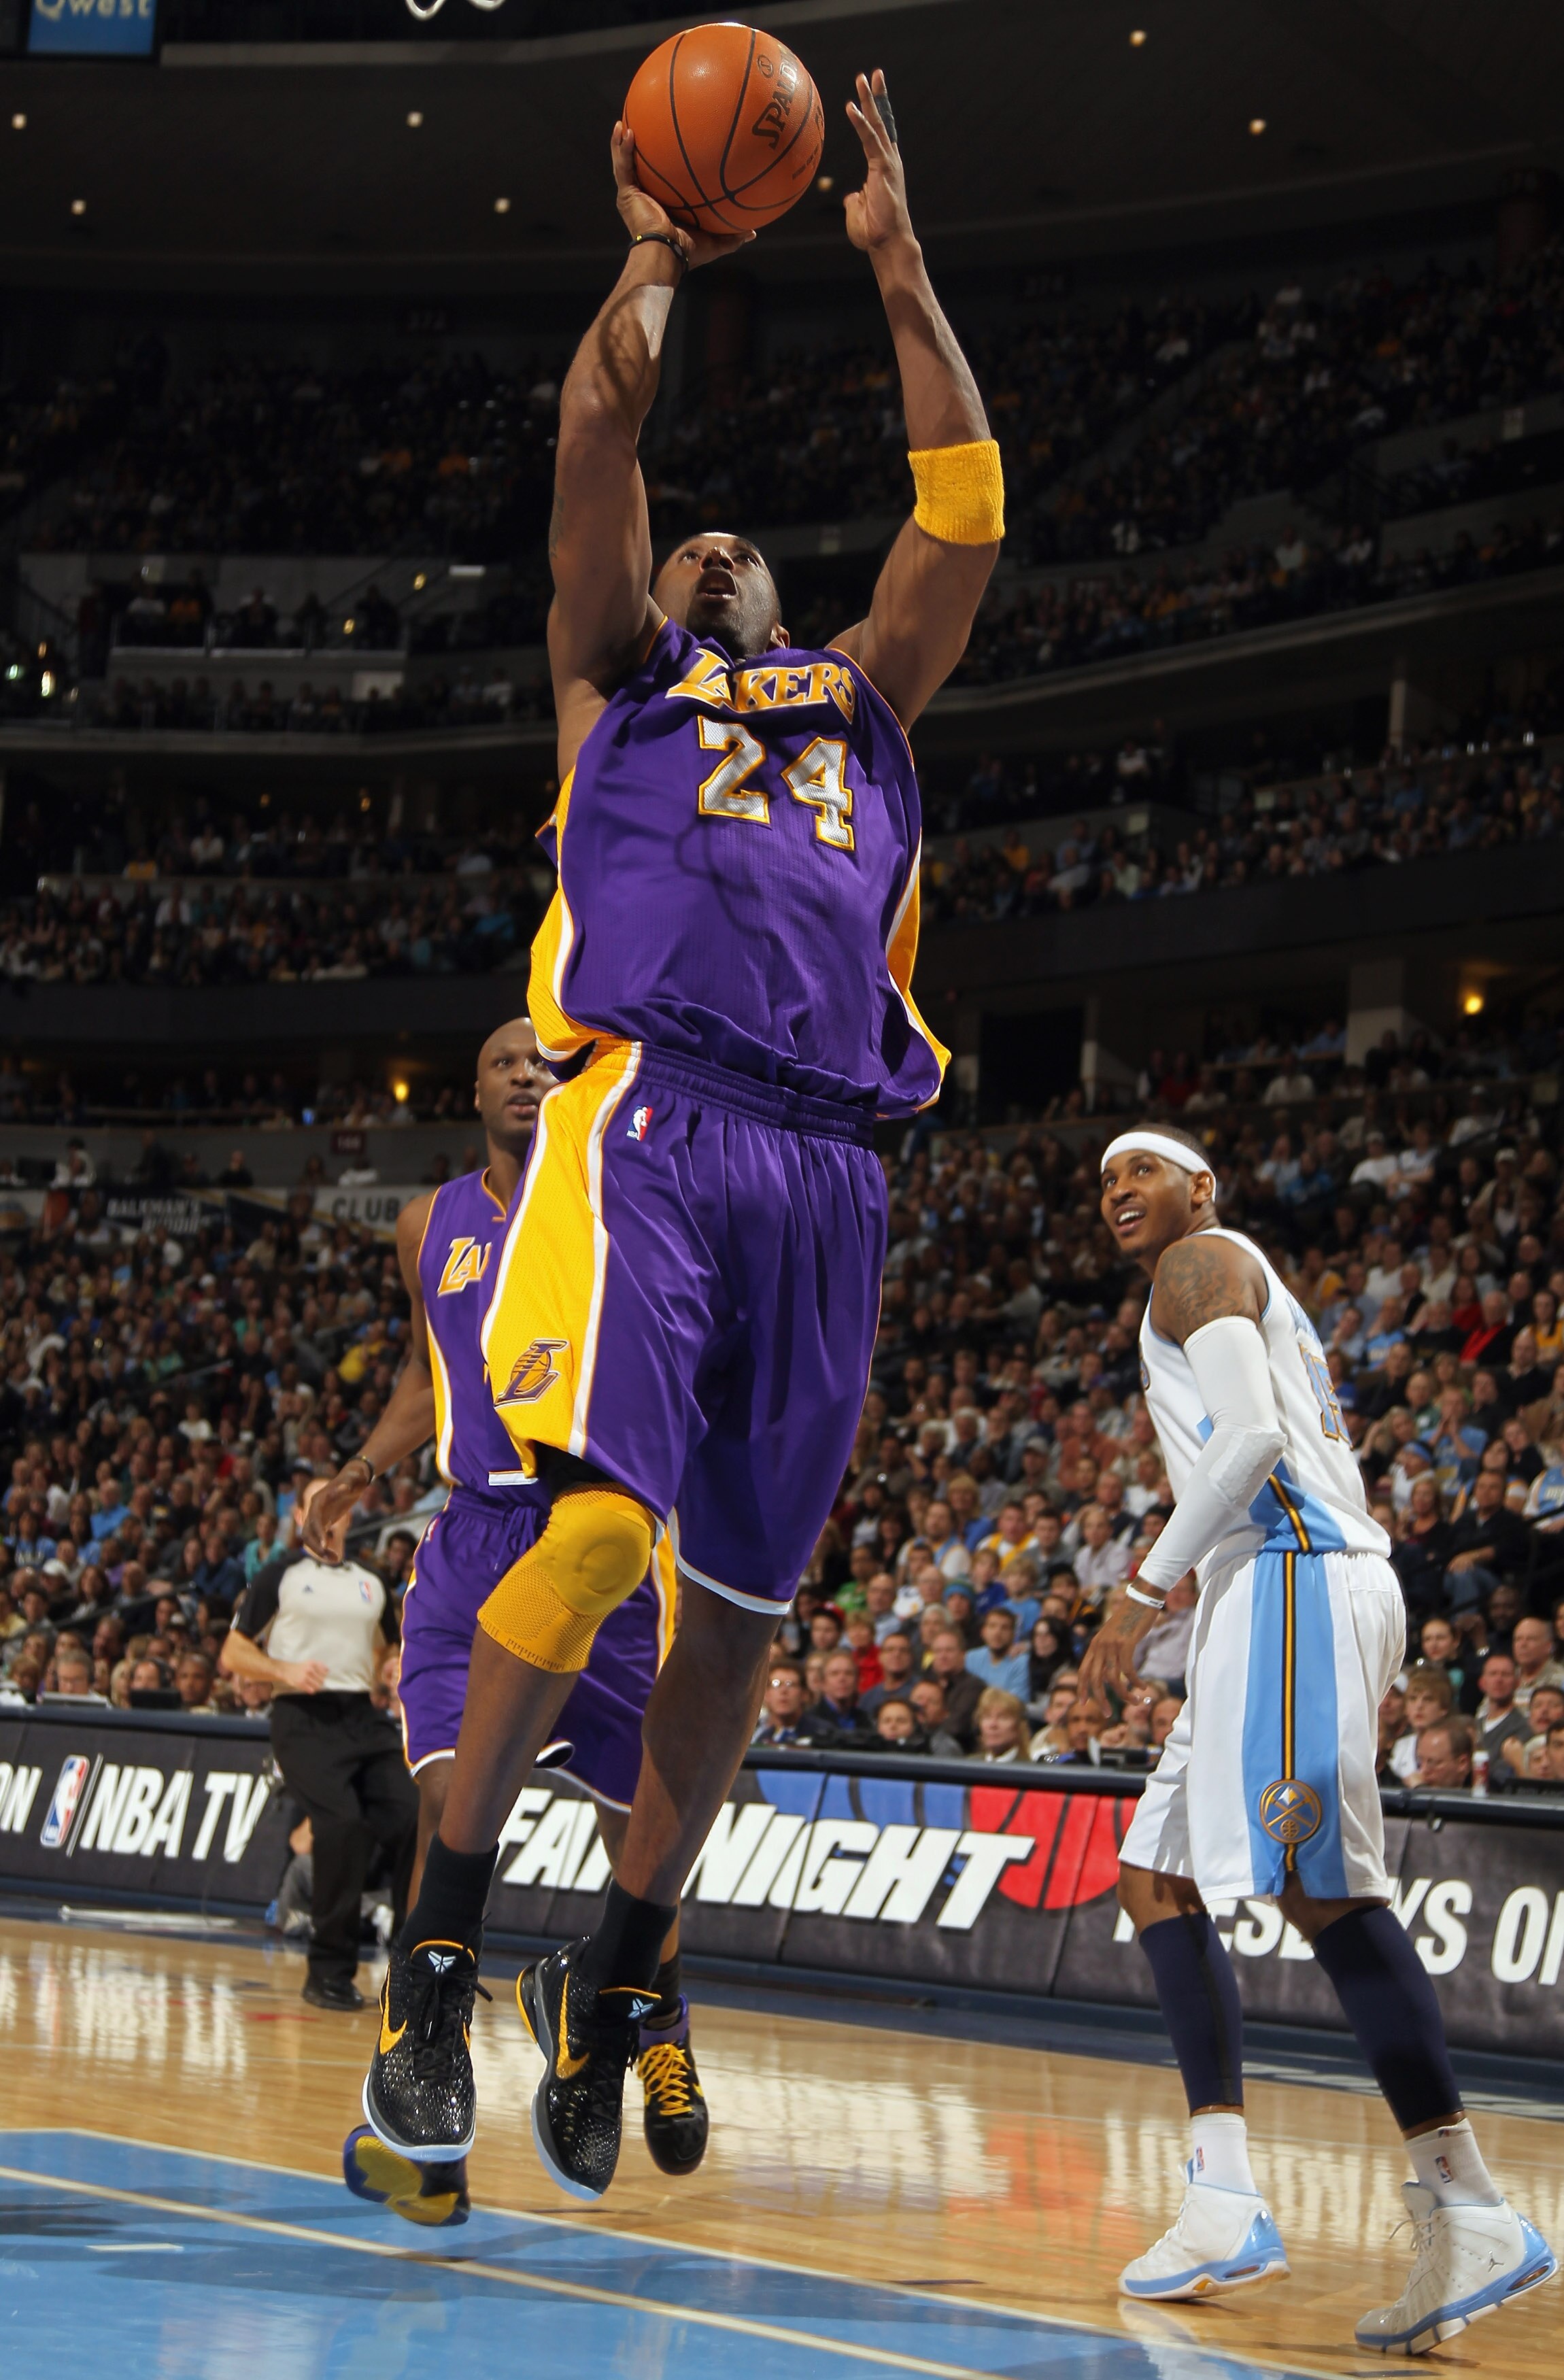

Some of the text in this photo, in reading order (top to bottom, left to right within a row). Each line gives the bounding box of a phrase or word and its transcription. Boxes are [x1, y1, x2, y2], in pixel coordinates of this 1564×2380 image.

[664, 647, 856, 725] LAKERS
[697, 715, 855, 851] 24
[331, 1197, 400, 1223] CLUB
[80, 1763, 271, 1863] NBA TV
[680, 1801, 1036, 1930] NIGHT
